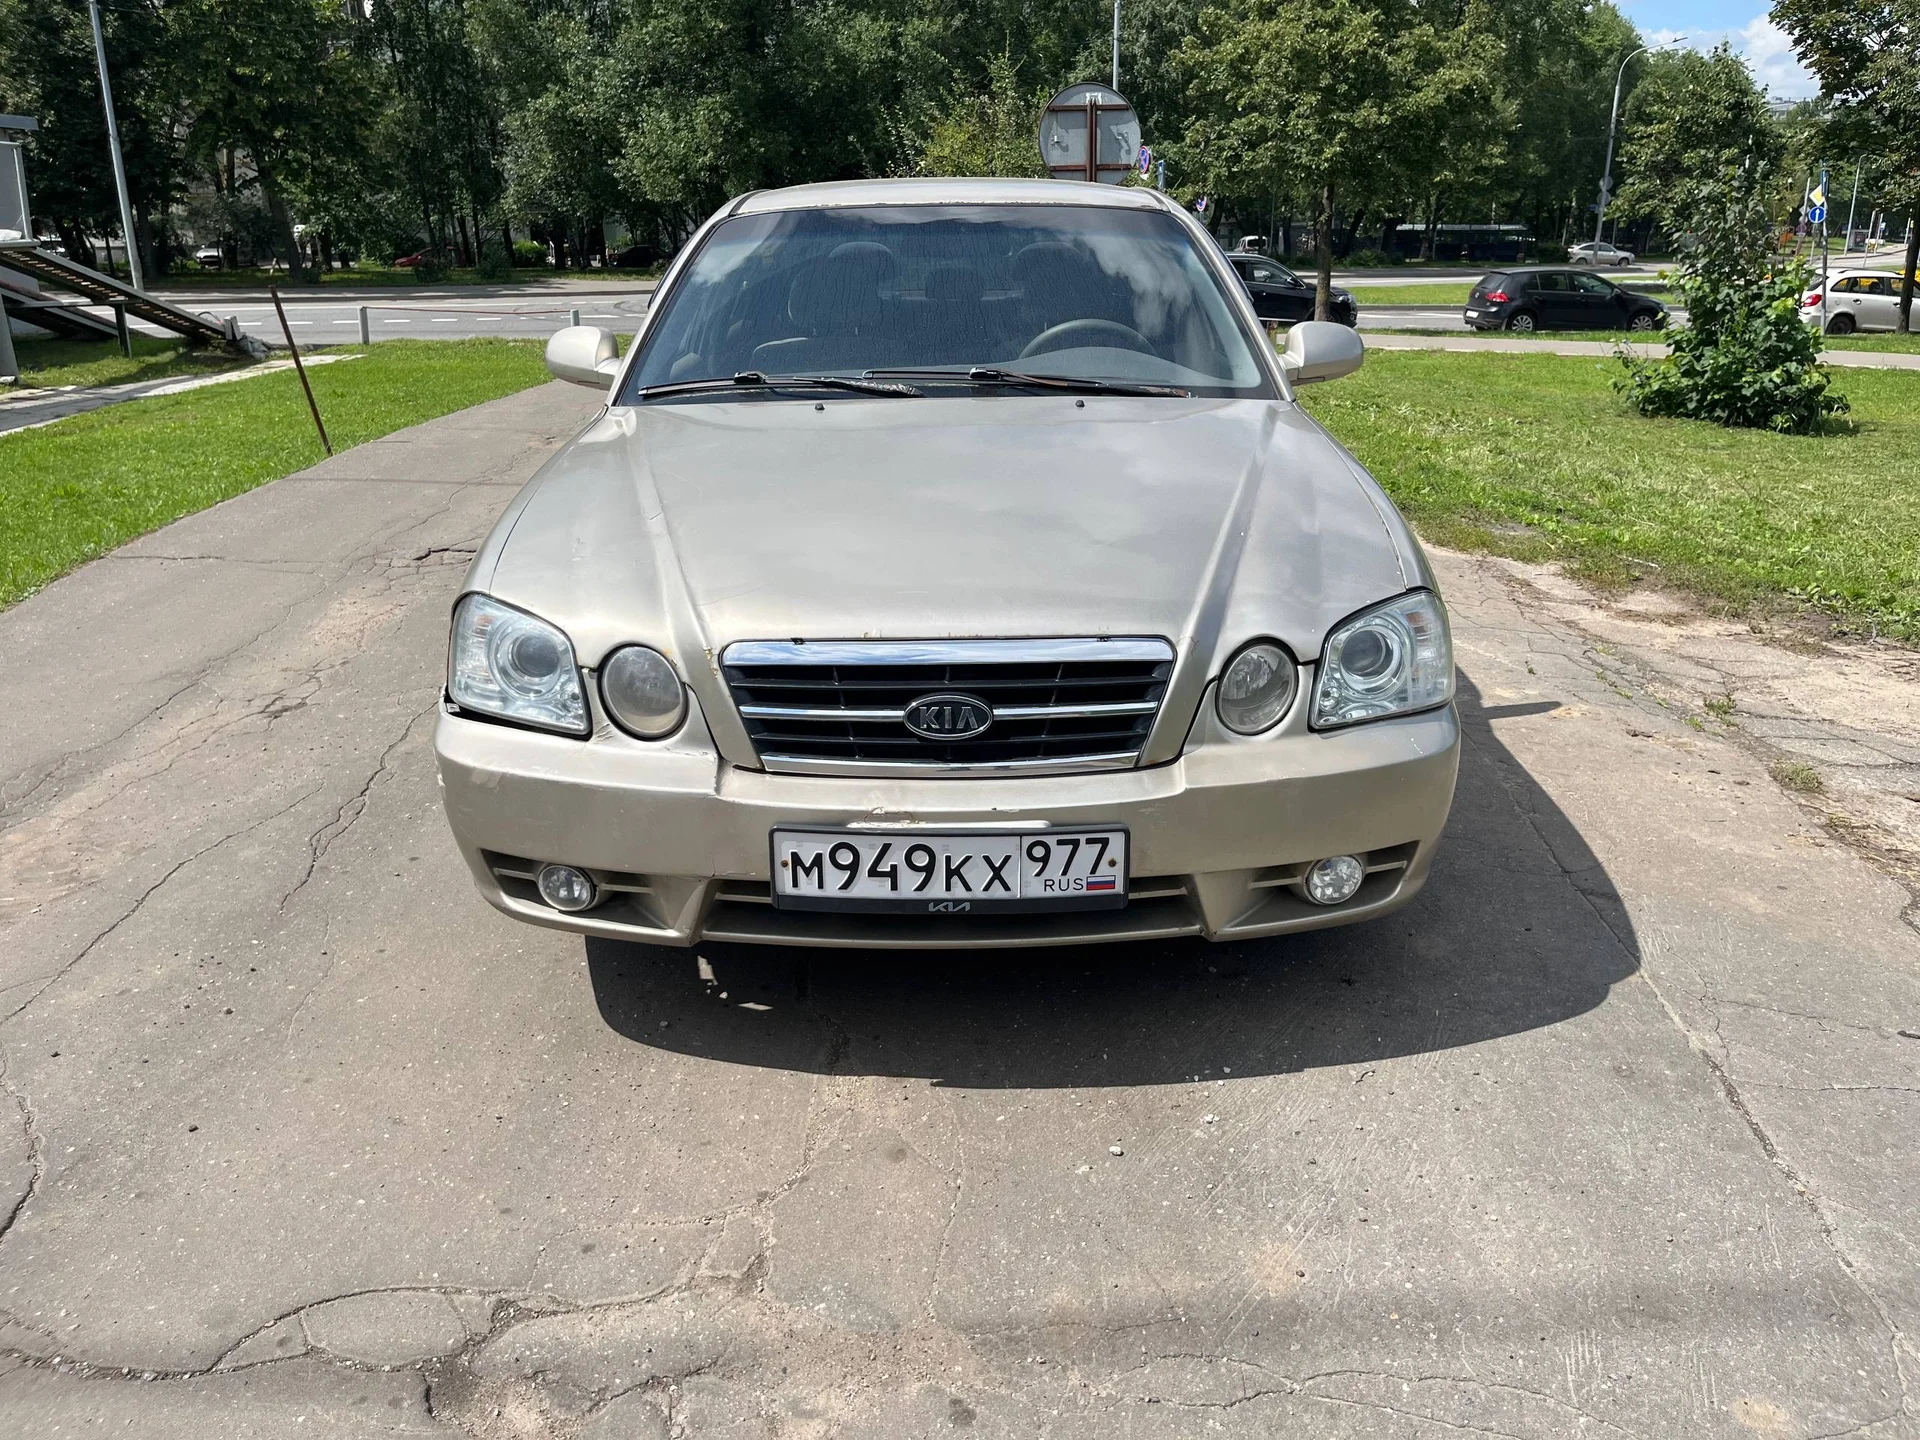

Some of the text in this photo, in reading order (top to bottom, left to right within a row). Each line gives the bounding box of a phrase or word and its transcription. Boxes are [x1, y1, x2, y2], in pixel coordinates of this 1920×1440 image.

[919, 706, 978, 729] KIA
[1025, 837, 1110, 877] 977
[1043, 877, 1084, 892] RUS
